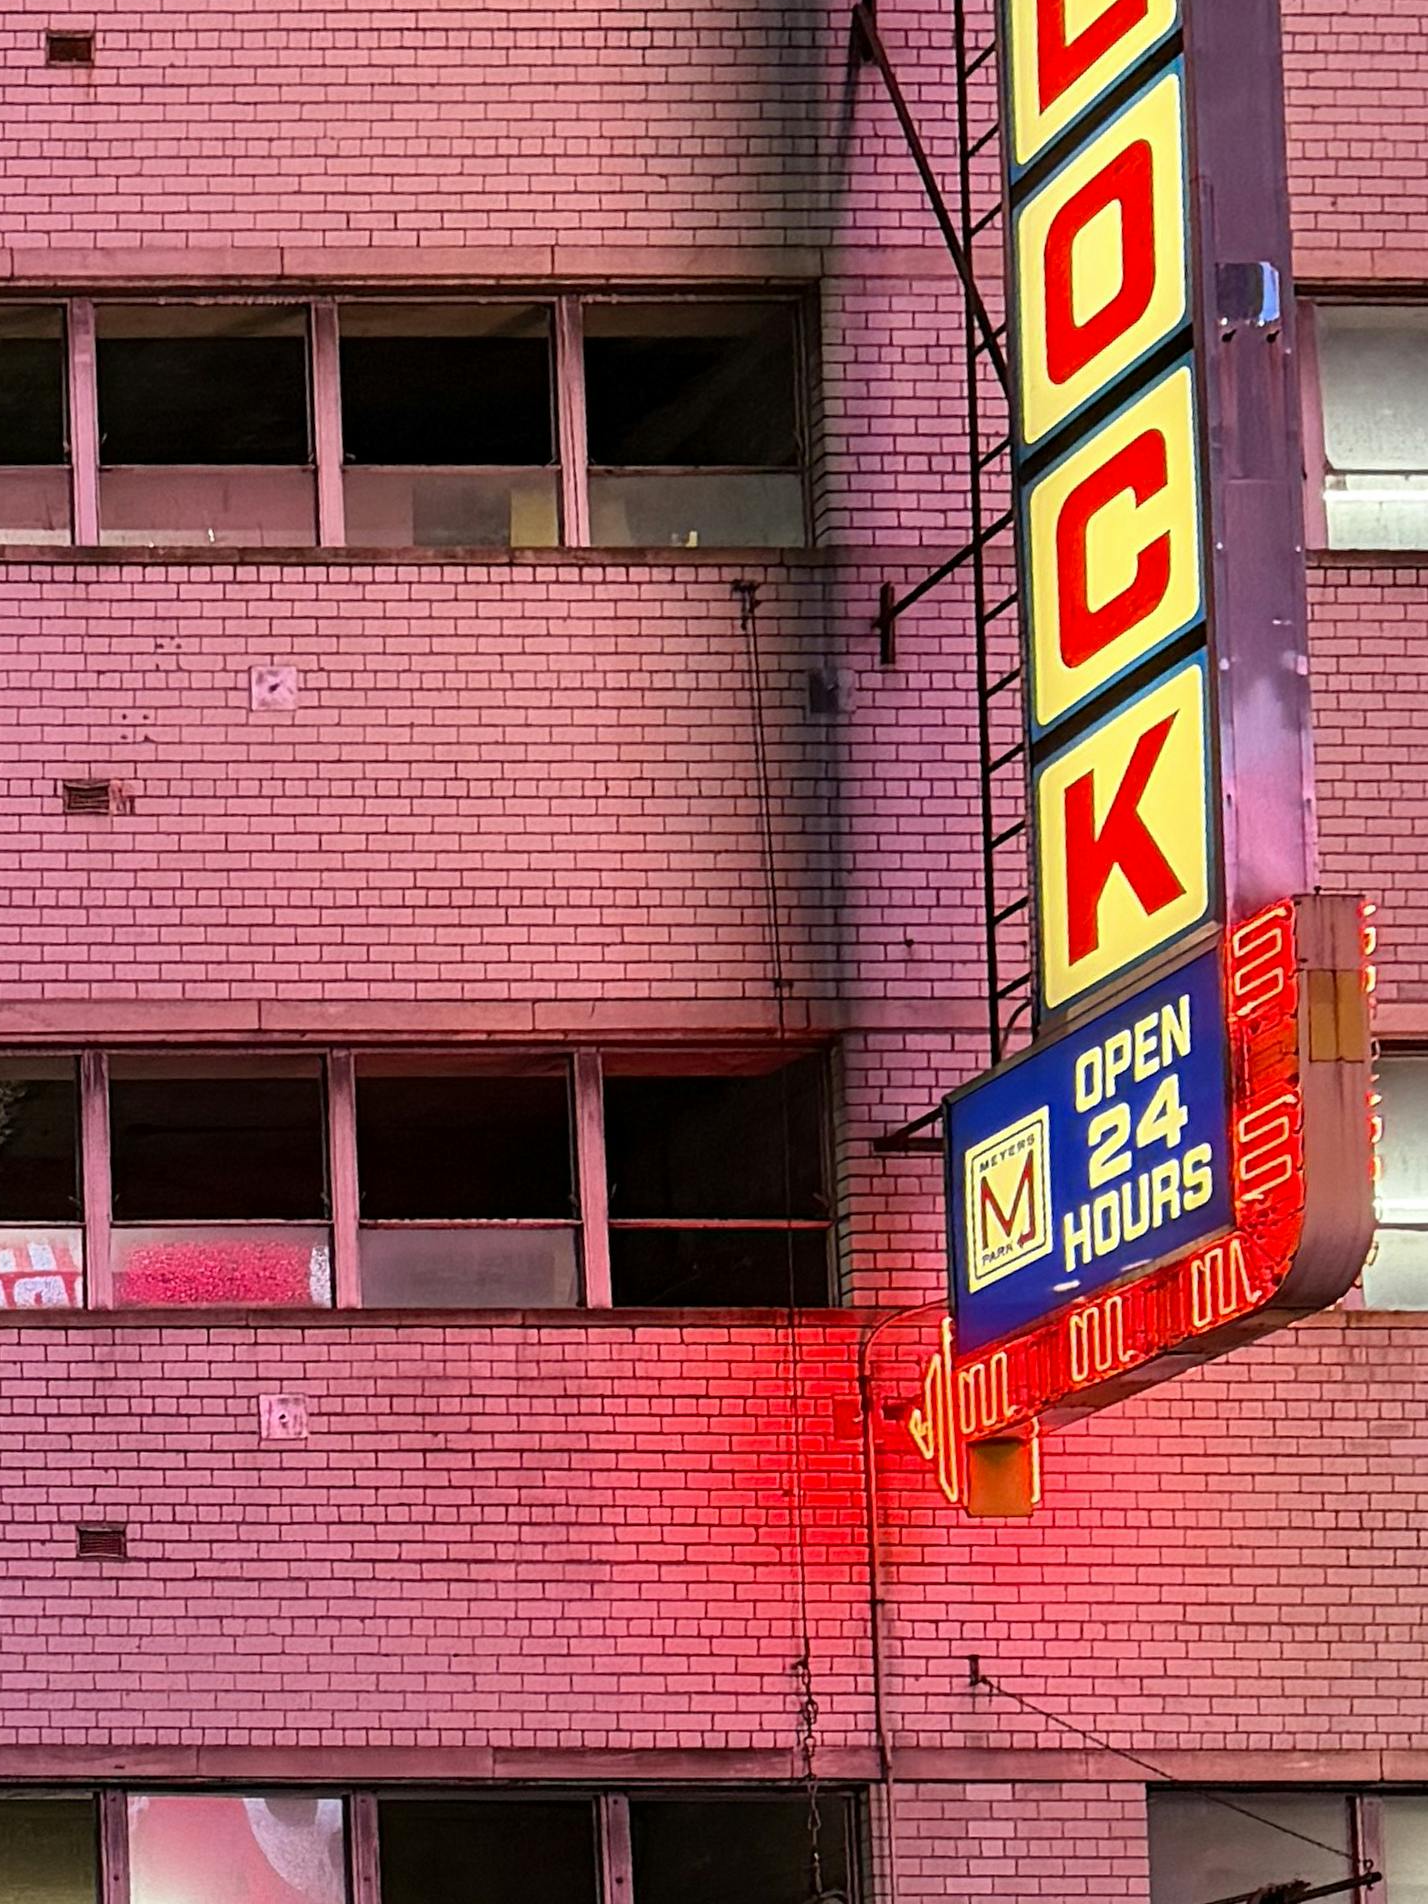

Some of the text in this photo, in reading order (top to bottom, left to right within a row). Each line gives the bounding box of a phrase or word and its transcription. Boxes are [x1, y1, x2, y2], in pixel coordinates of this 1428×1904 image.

[1075, 994, 1191, 1113] OPEN
[980, 1133, 1035, 1172] MEYERS
[1086, 1073, 1189, 1189] 24
[982, 1241, 1014, 1266] PARK
[1064, 1144, 1212, 1272] HOURS
